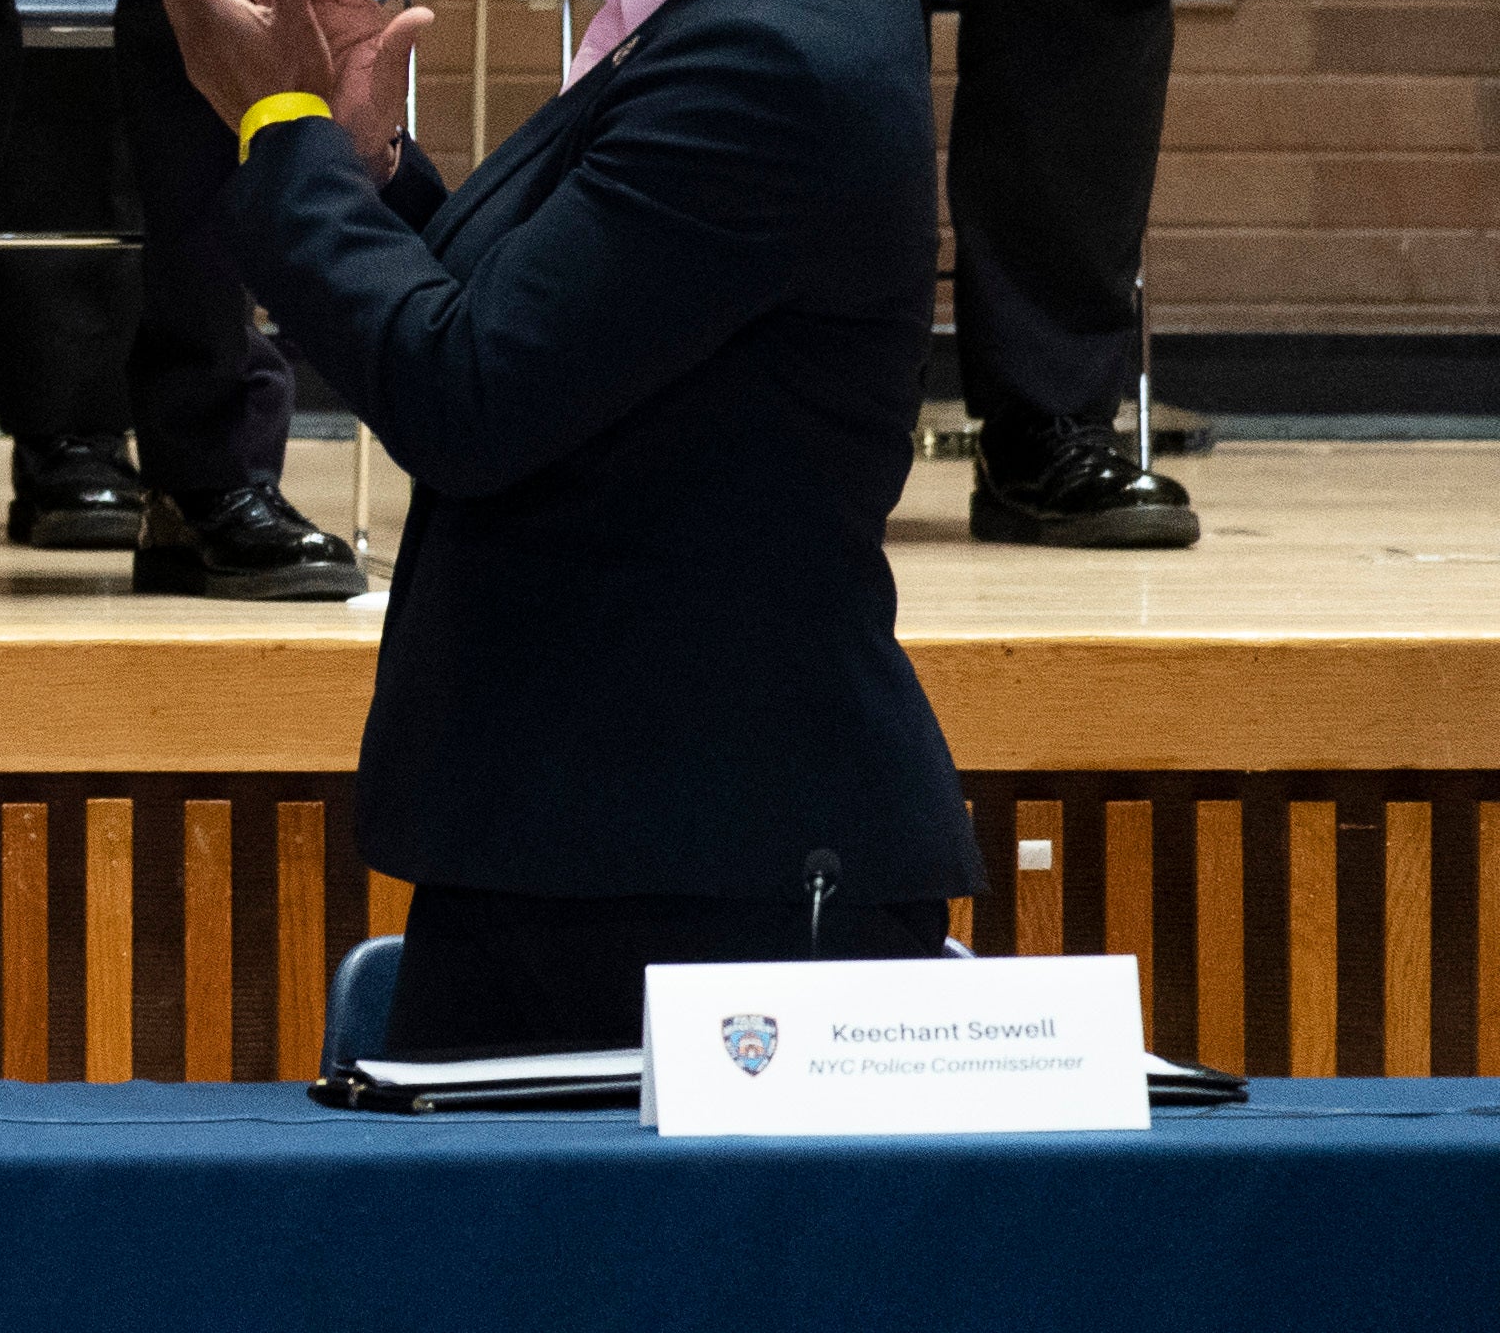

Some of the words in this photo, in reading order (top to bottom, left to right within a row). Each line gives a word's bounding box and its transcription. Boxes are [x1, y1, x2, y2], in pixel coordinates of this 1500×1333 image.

[832, 1023, 959, 1043] Keechant
[967, 1018, 1056, 1041] Sewell
[809, 1059, 855, 1076] NYC
[861, 1057, 926, 1075] Police
[931, 1054, 1083, 1075] Commissioner
